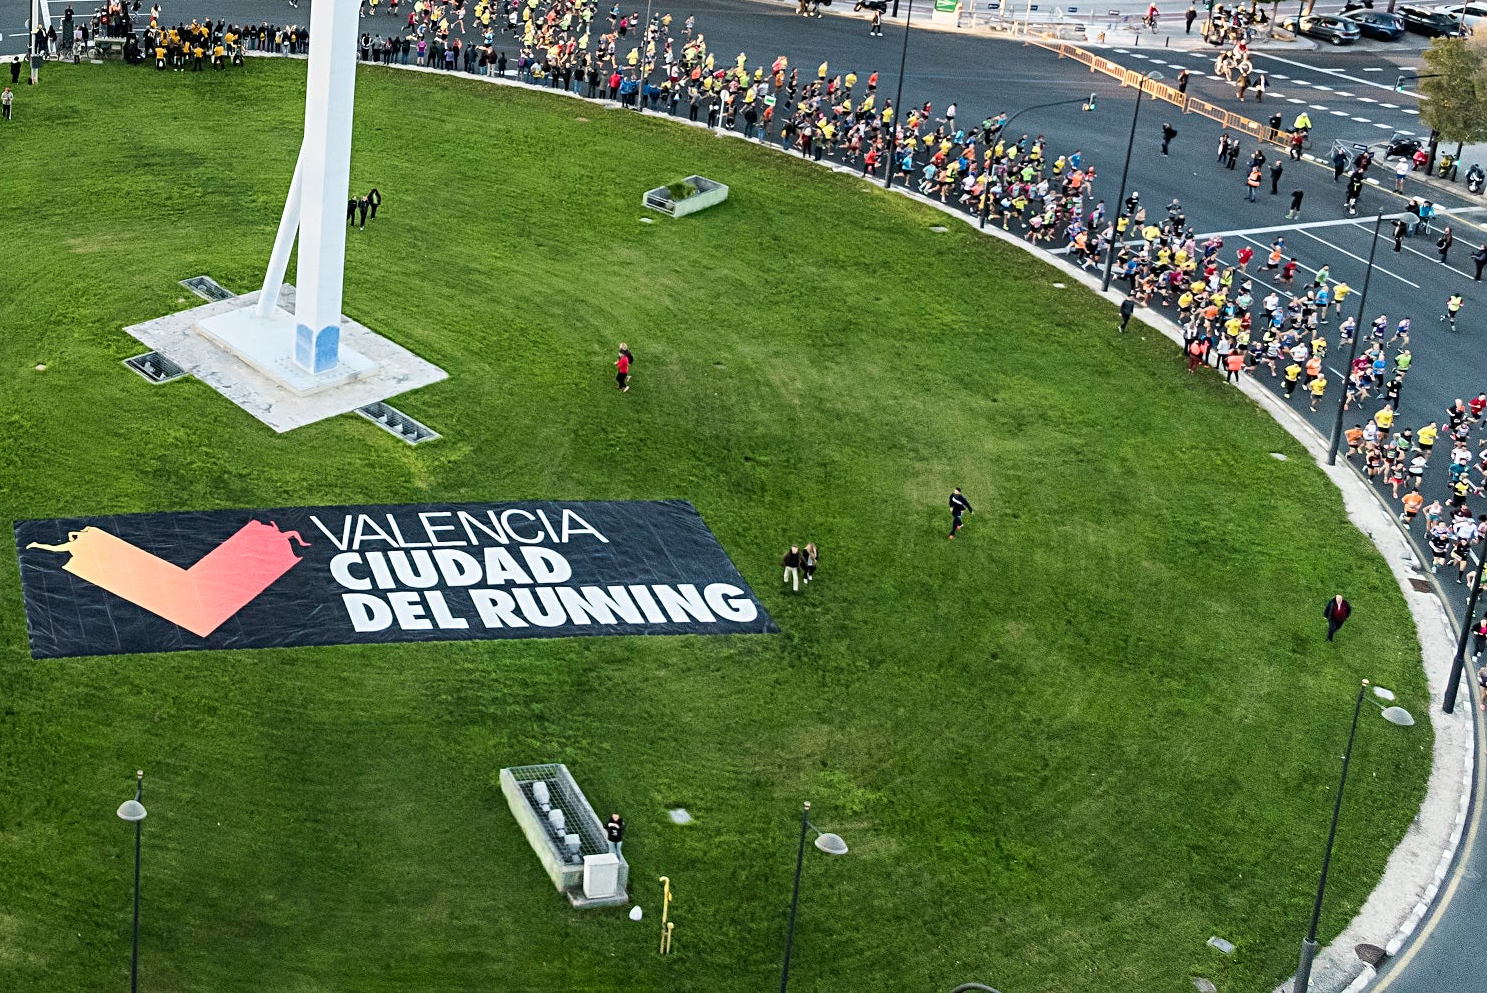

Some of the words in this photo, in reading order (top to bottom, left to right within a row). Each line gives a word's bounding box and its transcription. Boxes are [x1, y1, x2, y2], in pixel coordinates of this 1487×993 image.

[309, 508, 609, 550] VALENCIA
[329, 546, 571, 590] CIUDAD
[342, 590, 469, 633] DEL
[469, 582, 758, 629] RUNNING
